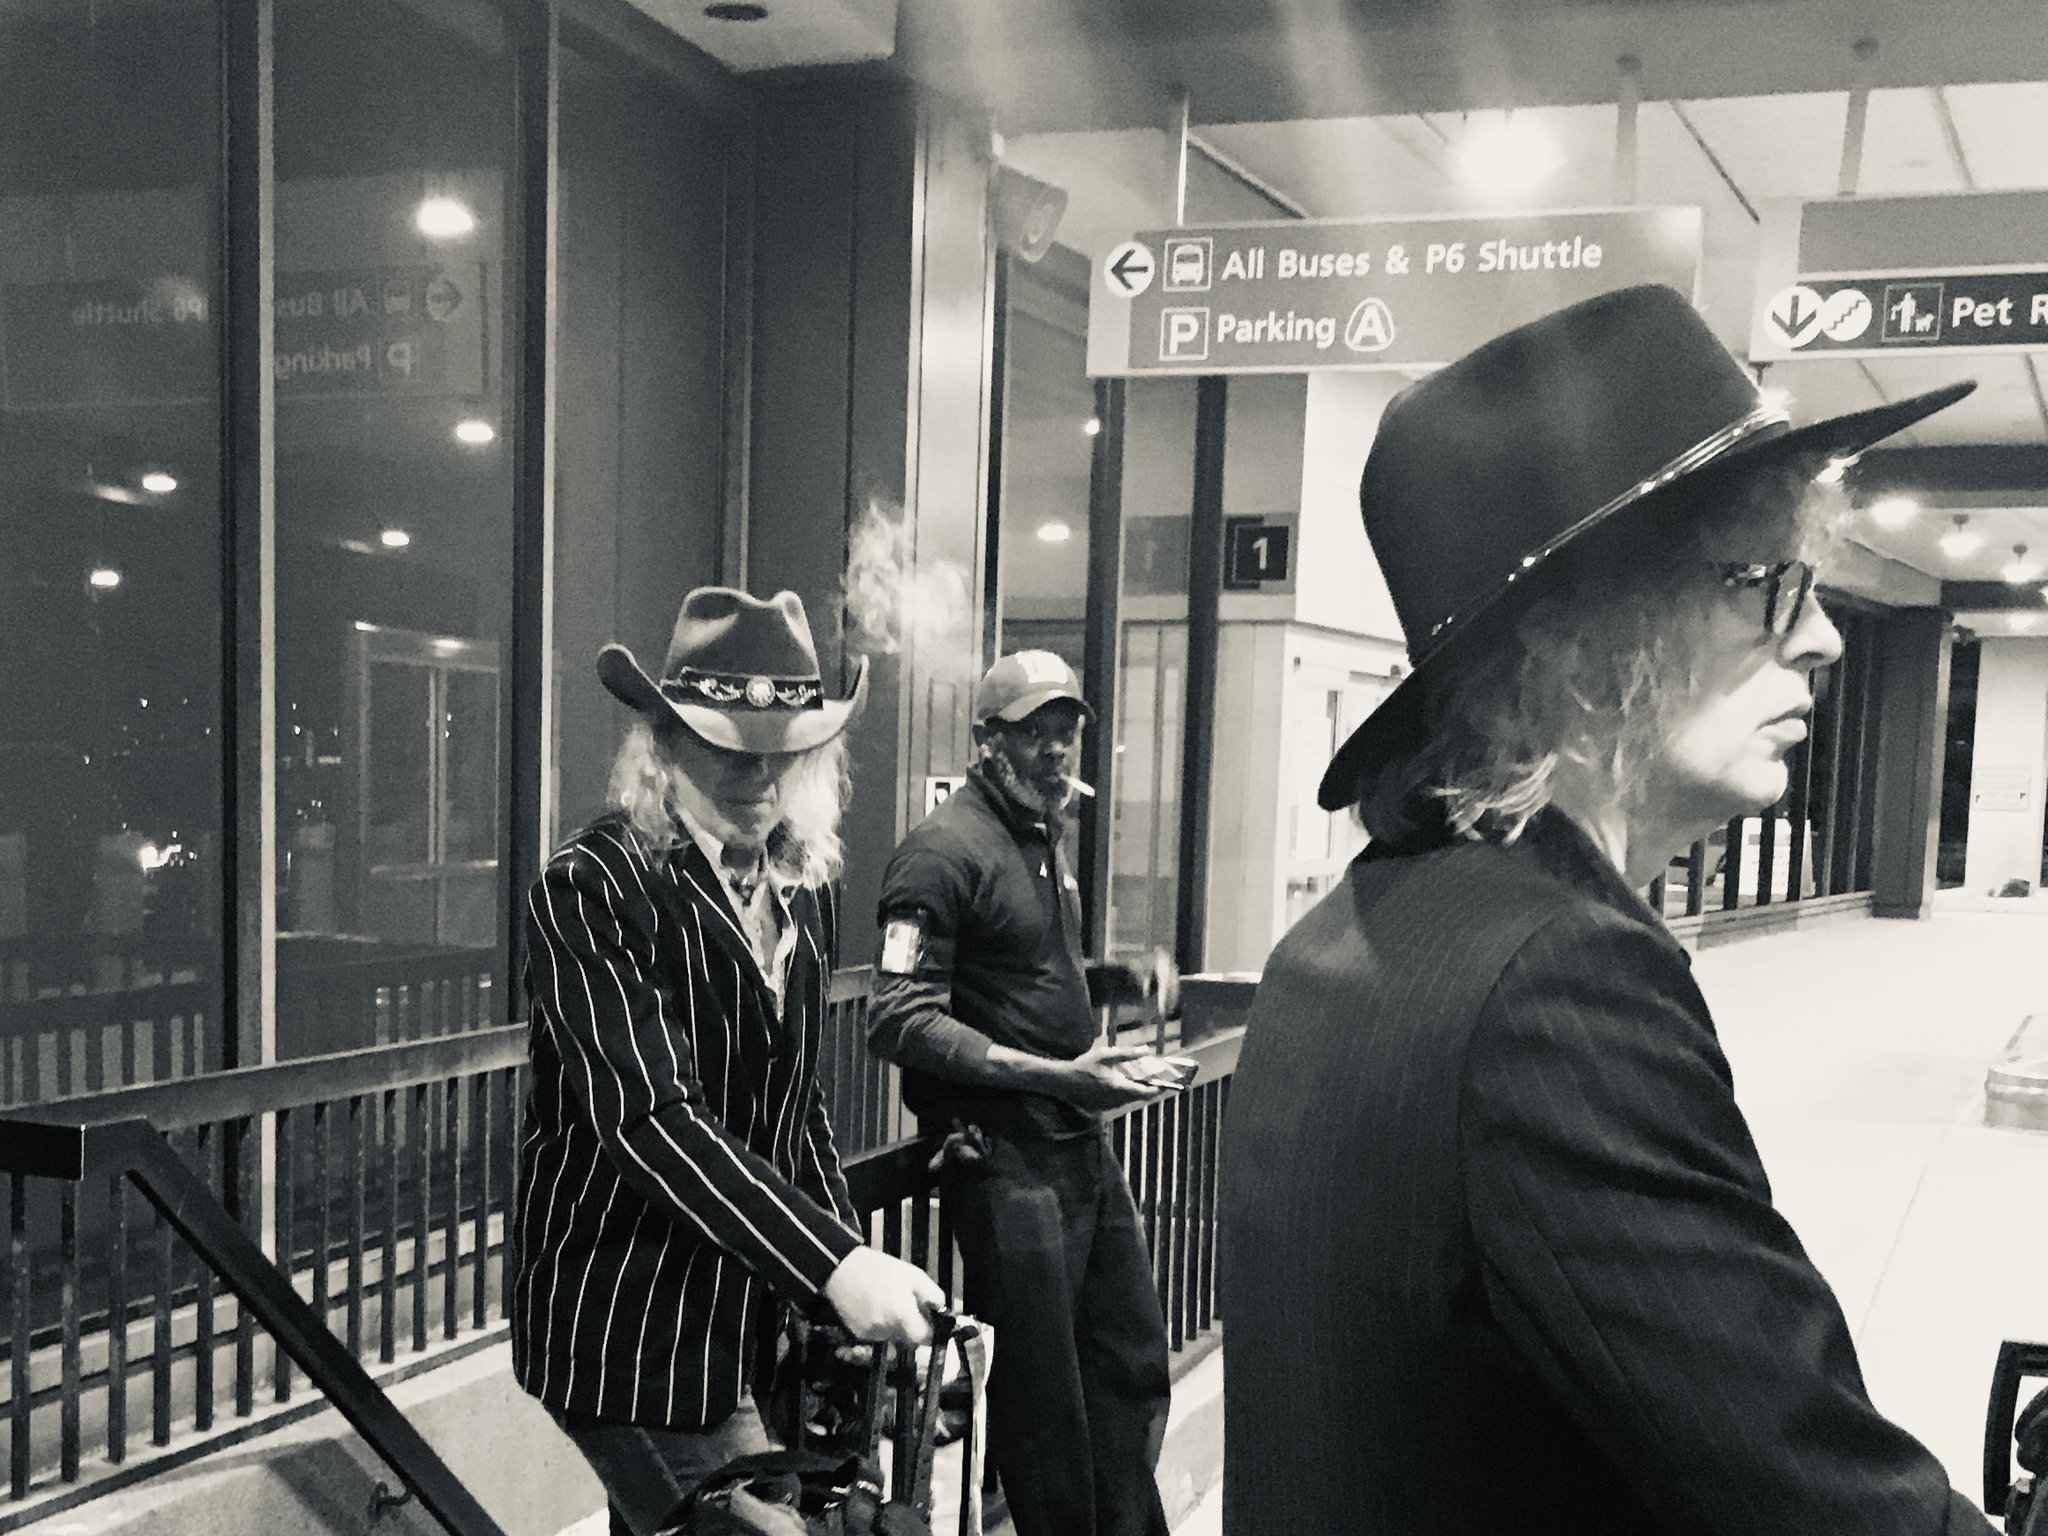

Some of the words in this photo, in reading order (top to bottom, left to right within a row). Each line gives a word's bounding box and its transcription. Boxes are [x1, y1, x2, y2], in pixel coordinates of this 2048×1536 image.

[1221, 247, 1265, 281] All
[1278, 246, 1371, 278] Buses
[1385, 243, 1410, 275] &
[1426, 241, 1465, 274] P6
[1477, 235, 1603, 272] Shuttle
[1169, 315, 1199, 354] P
[1216, 310, 1337, 350] Parking
[1354, 306, 1389, 344] A
[1952, 296, 2014, 328] Pet
[1253, 537, 1268, 570] 1
